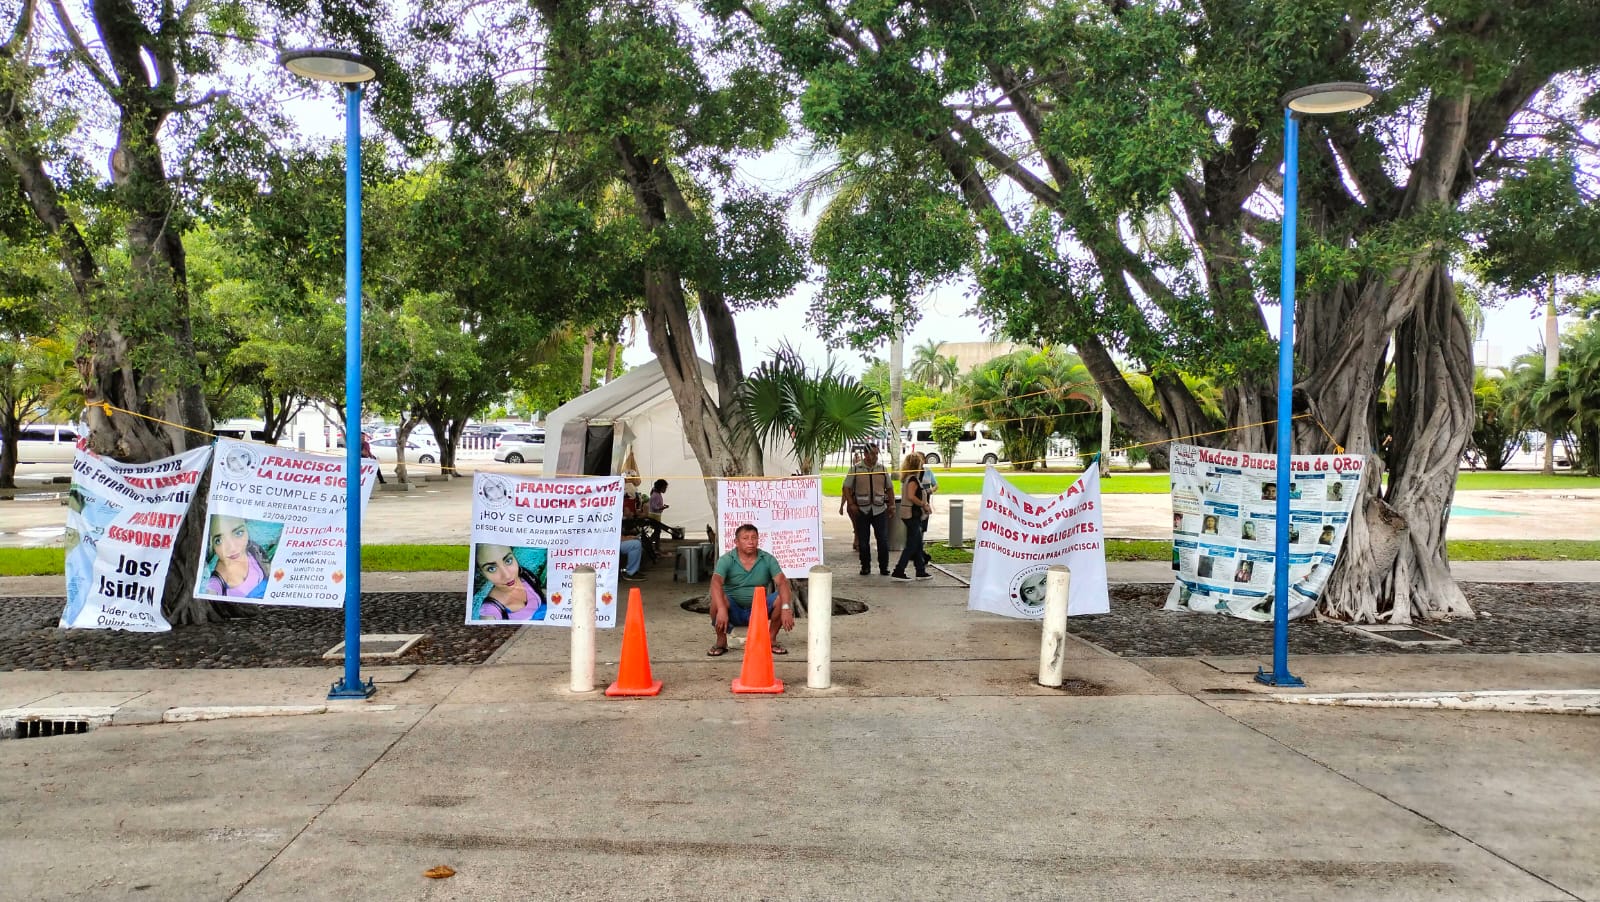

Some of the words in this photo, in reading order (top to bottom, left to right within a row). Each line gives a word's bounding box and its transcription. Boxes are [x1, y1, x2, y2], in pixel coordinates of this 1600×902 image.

[73, 456, 92, 476] uis
[261, 456, 342, 473] ¡FRANCISCA
[1199, 449, 1238, 467] Madres
[1241, 454, 1310, 472] Buscaras
[1315, 458, 1329, 471] de
[257, 468, 274, 480] LA
[276, 472, 321, 485] LUCHA
[324, 475, 366, 489] SIG!
[216, 480, 245, 493] ¡HOY
[249, 485, 262, 494] SE
[266, 488, 317, 501] CUMPLE
[320, 493, 327, 502] 5
[330, 493, 348, 505] AÑ
[515, 482, 593, 495] ¡FRANCISCA
[727, 488, 737, 498] EN
[212, 494, 233, 503] DESDE
[236, 497, 253, 506] QUE
[267, 501, 327, 514] ARREBATASTES
[515, 496, 530, 508] LA
[533, 498, 577, 509] LUCHA
[580, 495, 616, 508] SIGUE!
[262, 512, 308, 523] 22/06/2020
[480, 510, 506, 521] ¡HOY
[508, 513, 523, 522] SE
[526, 514, 575, 524] CUMPLE
[577, 514, 584, 523] 5
[587, 511, 613, 523] AÑOS
[981, 520, 1019, 542] OMISOS
[1021, 532, 1029, 543] Y
[1031, 522, 1098, 545] NEGLIGENTES.
[525, 538, 569, 546] 22/06/2020
[550, 548, 597, 558] ¡JUSTICIA
[978, 540, 1011, 557] ¡EXIGIMOS
[1011, 551, 1045, 561] JUSTICIA
[1045, 551, 1060, 560] PARA
[270, 591, 313, 599] QUEMENLO
